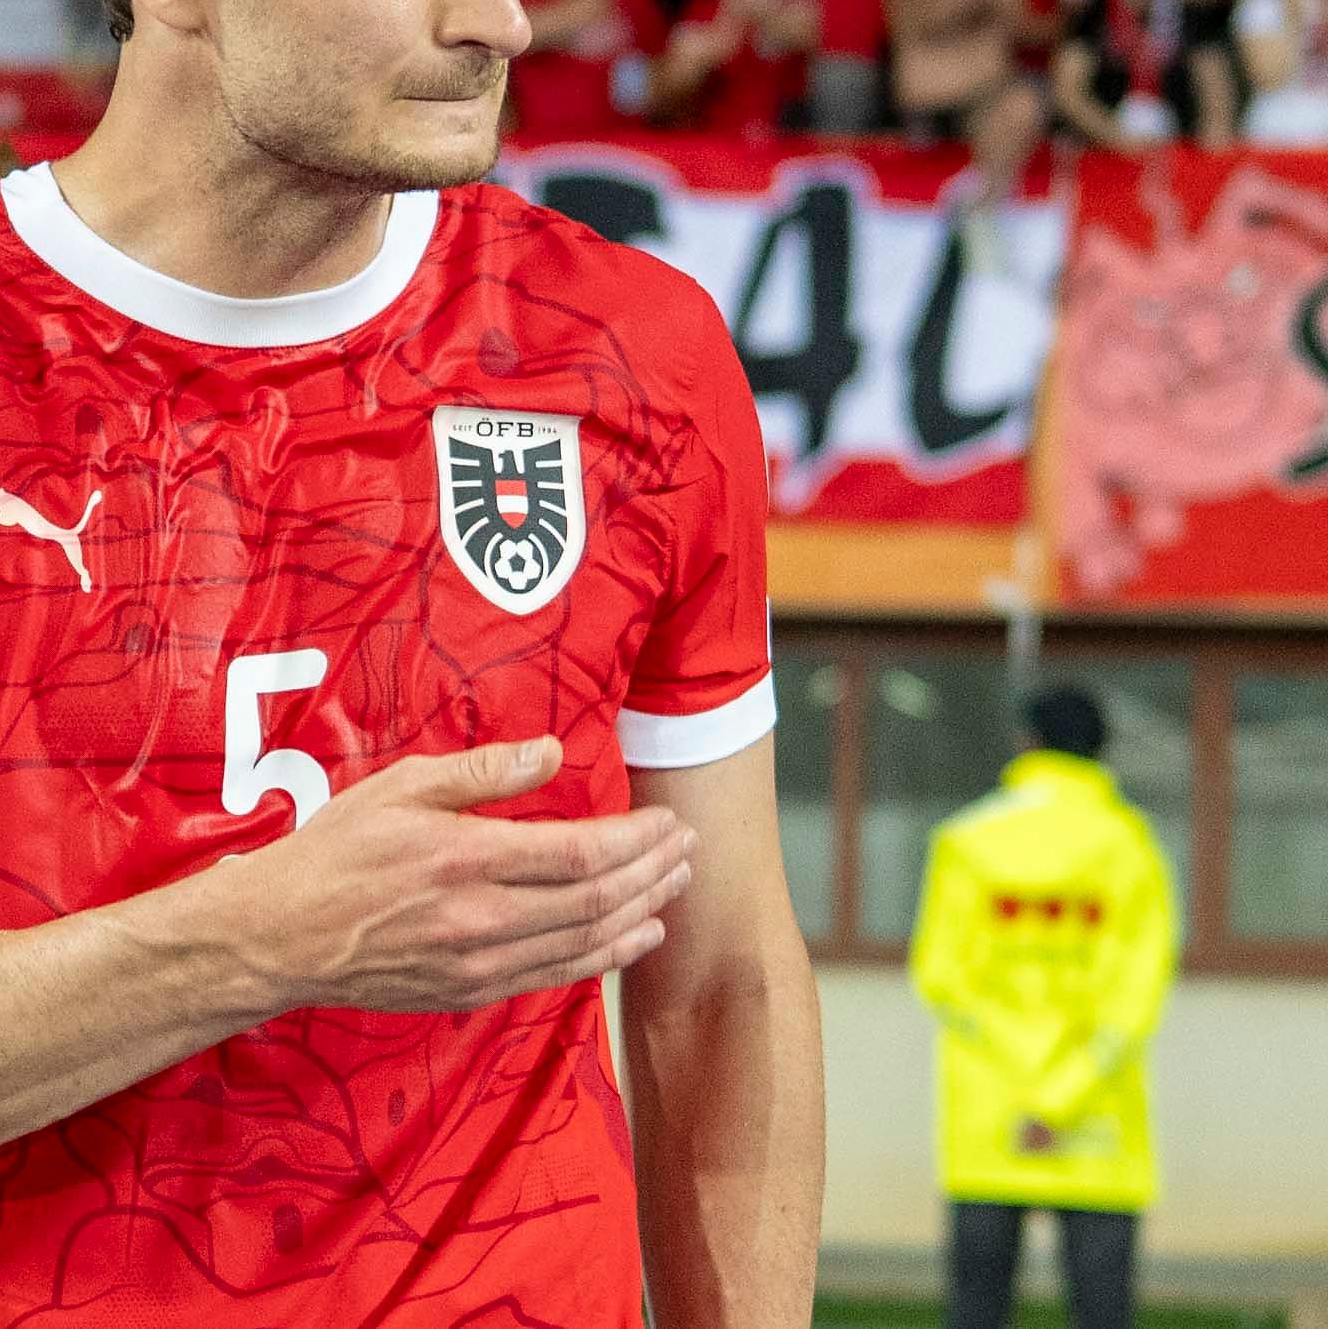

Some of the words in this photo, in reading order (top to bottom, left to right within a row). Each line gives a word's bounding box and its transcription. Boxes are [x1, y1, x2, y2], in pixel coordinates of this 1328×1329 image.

[452, 424, 472, 432] SEIT
[476, 417, 535, 438] ÖFB
[222, 648, 331, 858] 5
